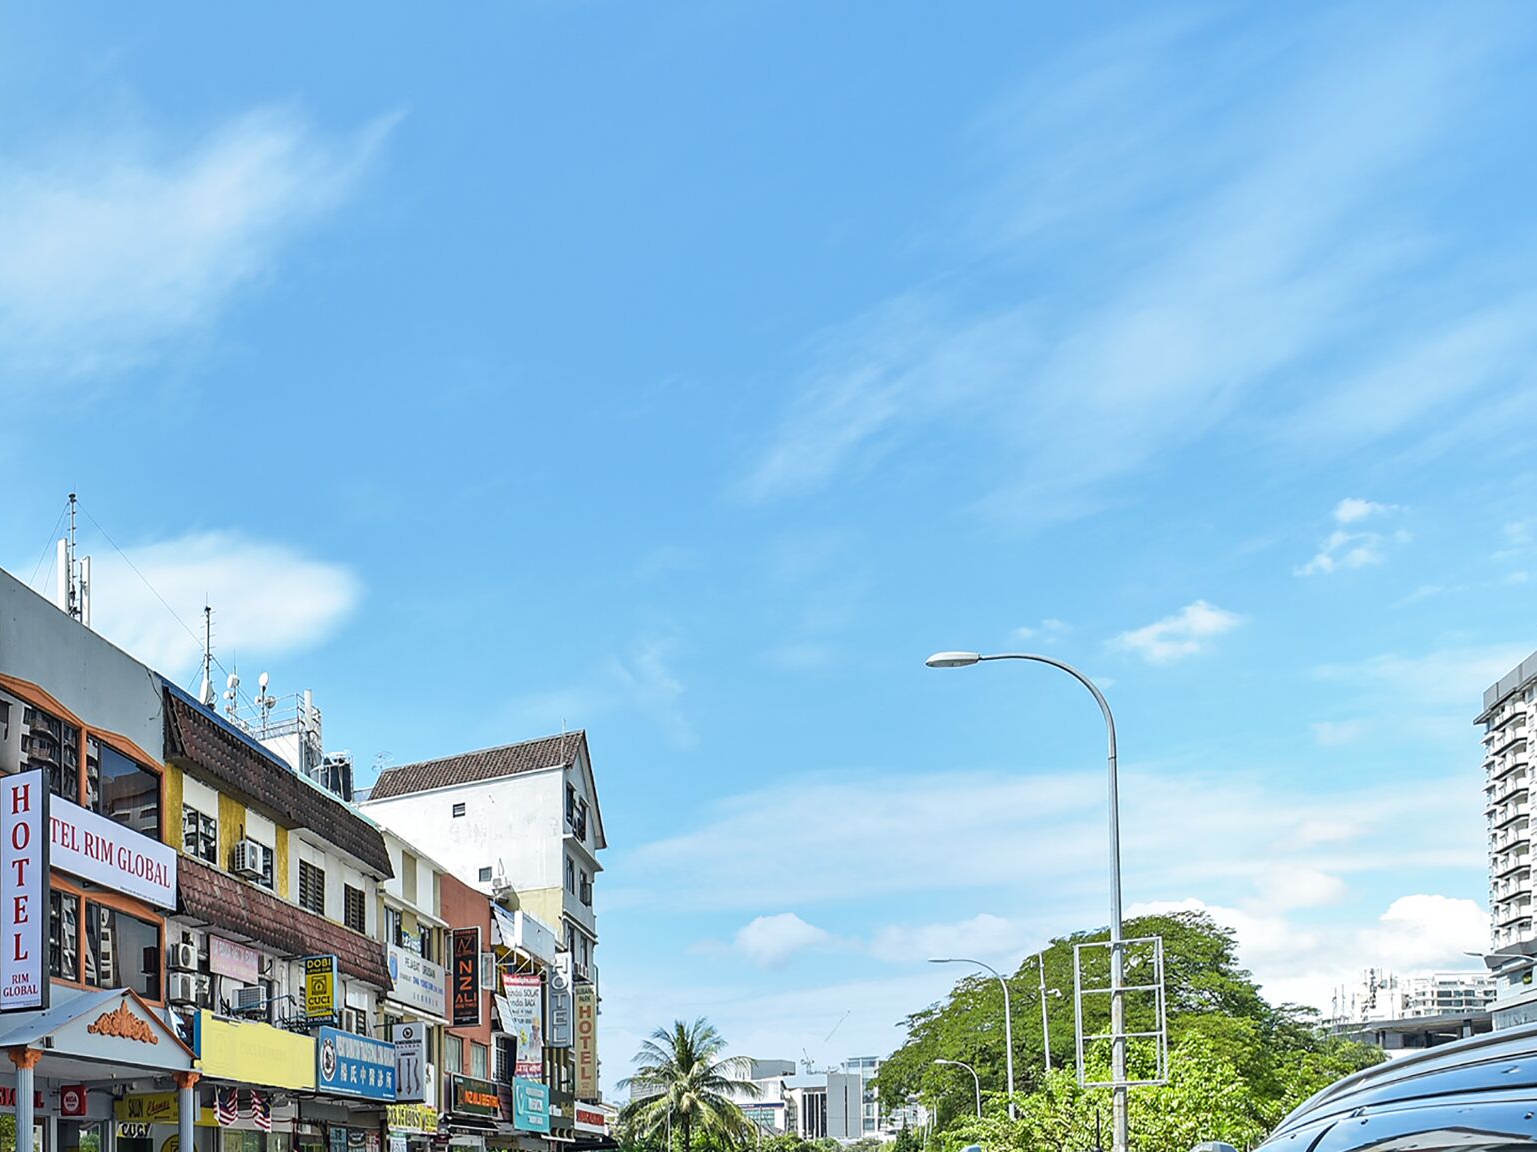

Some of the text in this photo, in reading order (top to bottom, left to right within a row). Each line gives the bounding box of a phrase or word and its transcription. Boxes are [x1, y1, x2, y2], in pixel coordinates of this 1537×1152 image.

[84, 831, 113, 866] RIM
[118, 847, 170, 888] GLOBAL
[11, 783, 31, 962] HOTEL
[307, 958, 331, 969] DOBI
[12, 973, 29, 984] RIM
[3, 985, 38, 997] GLOBAL
[308, 996, 330, 1005] CUCI
[579, 1005, 591, 1080] HOTEL
